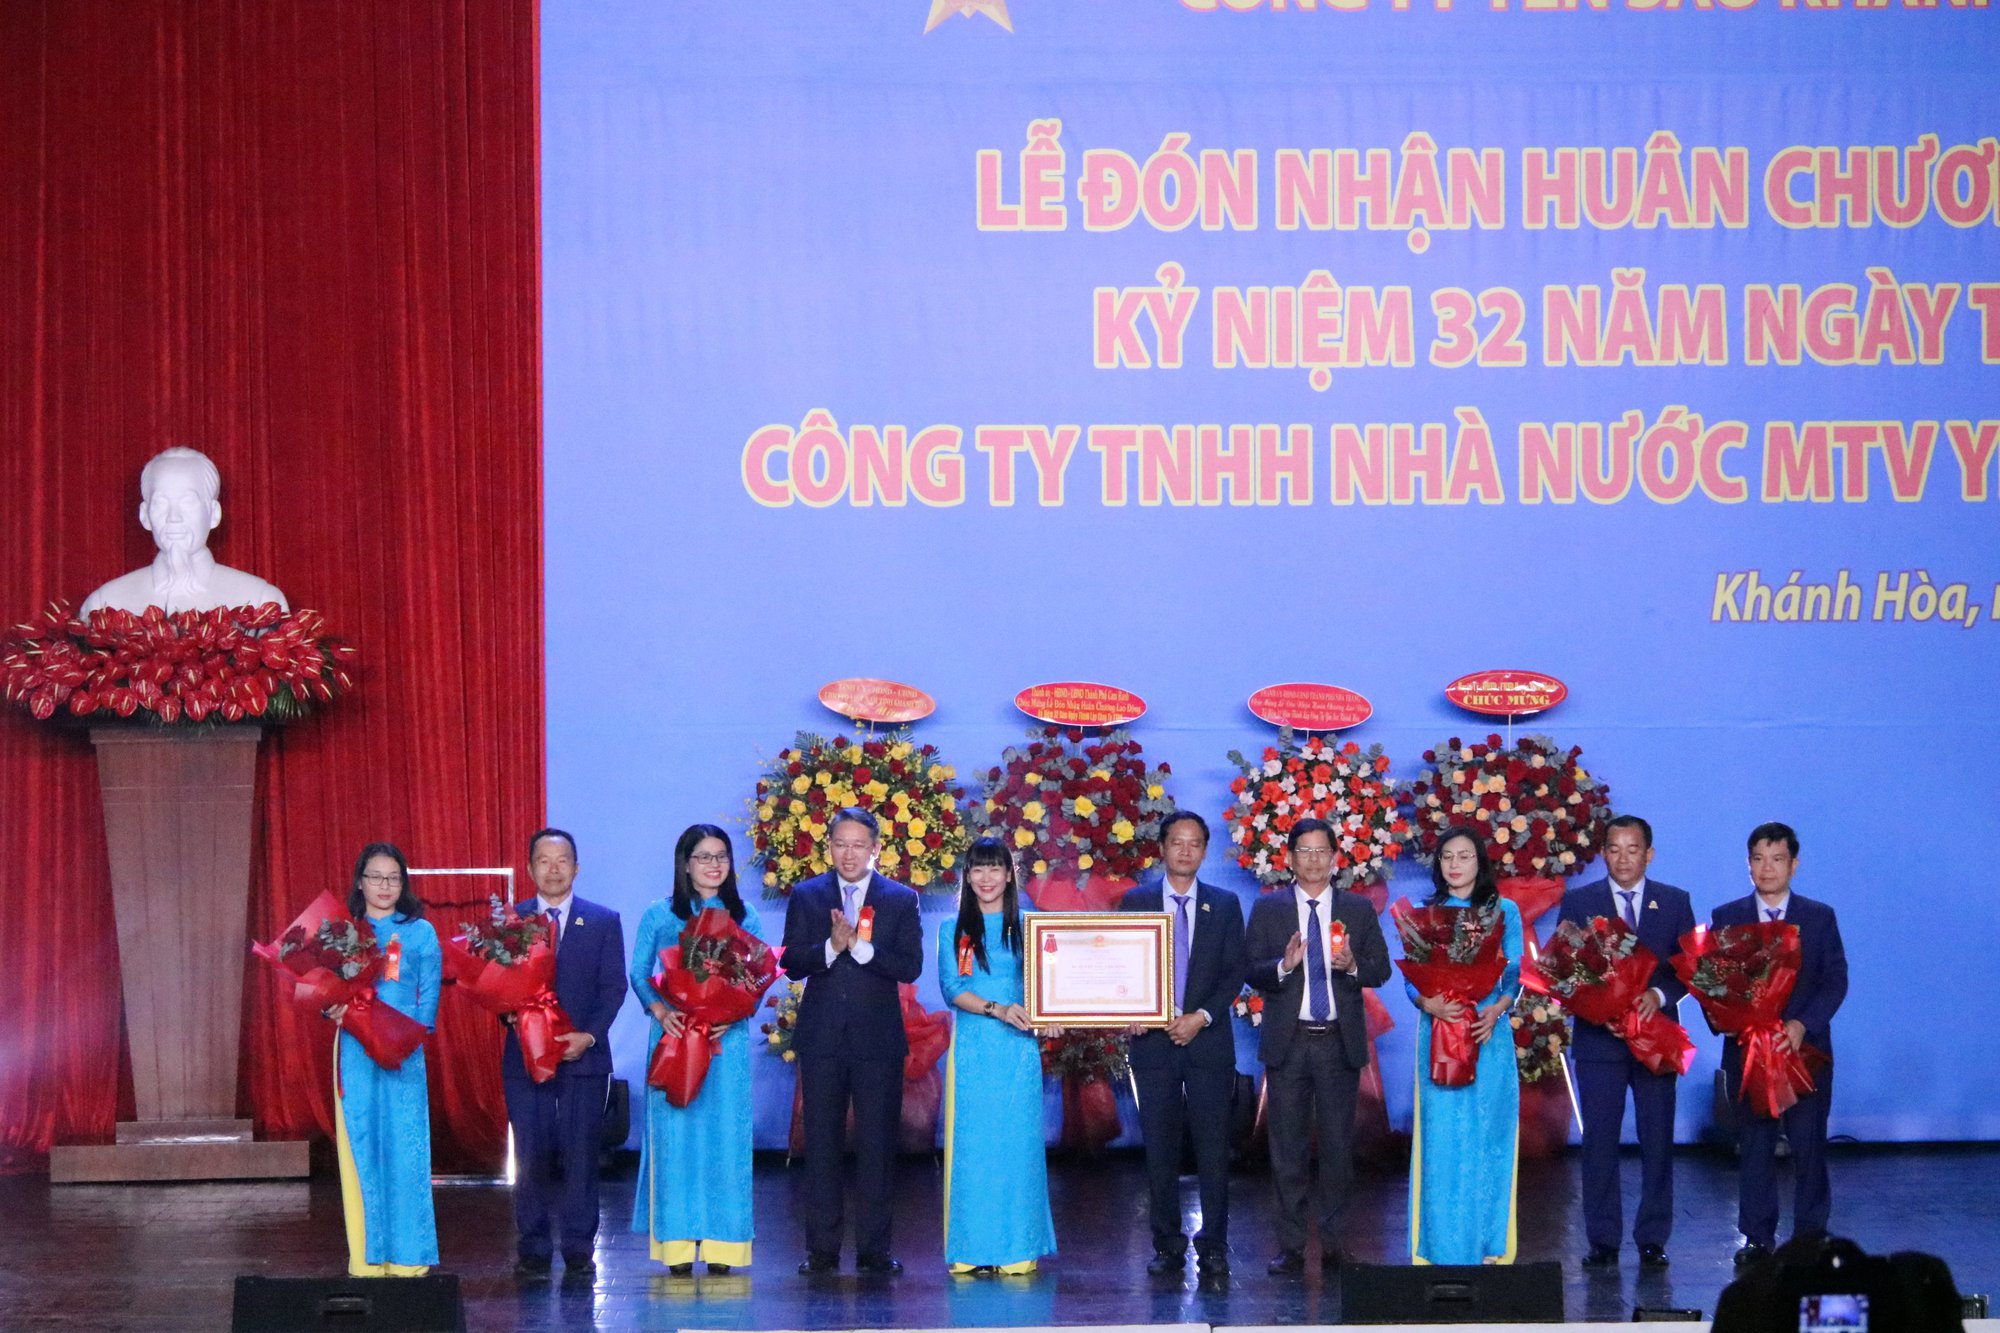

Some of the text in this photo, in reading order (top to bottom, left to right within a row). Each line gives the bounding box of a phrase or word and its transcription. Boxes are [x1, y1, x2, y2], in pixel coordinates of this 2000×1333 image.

[977, 119, 2000, 252] LỄ ĐÓN NHẬN HUÂN CHƯƠ
[1094, 260, 1200, 369] KỶ
[1213, 269, 1415, 391] NIỆM
[1430, 287, 1527, 368] 32
[1544, 267, 1728, 367] NĂM
[1746, 267, 1961, 366] NGÀY
[741, 408, 965, 508] CÔNG
[976, 424, 1080, 507] TY
[1088, 424, 1313, 506] TNHH
[1332, 406, 1505, 505] NHÀ
[1520, 405, 1748, 504] NƯỚC
[1762, 421, 1939, 502] MTV
[1712, 571, 1861, 622] Khánh
[1873, 570, 1981, 629] Hòa,
[1463, 692, 1551, 706] CHÚC MỪNG
